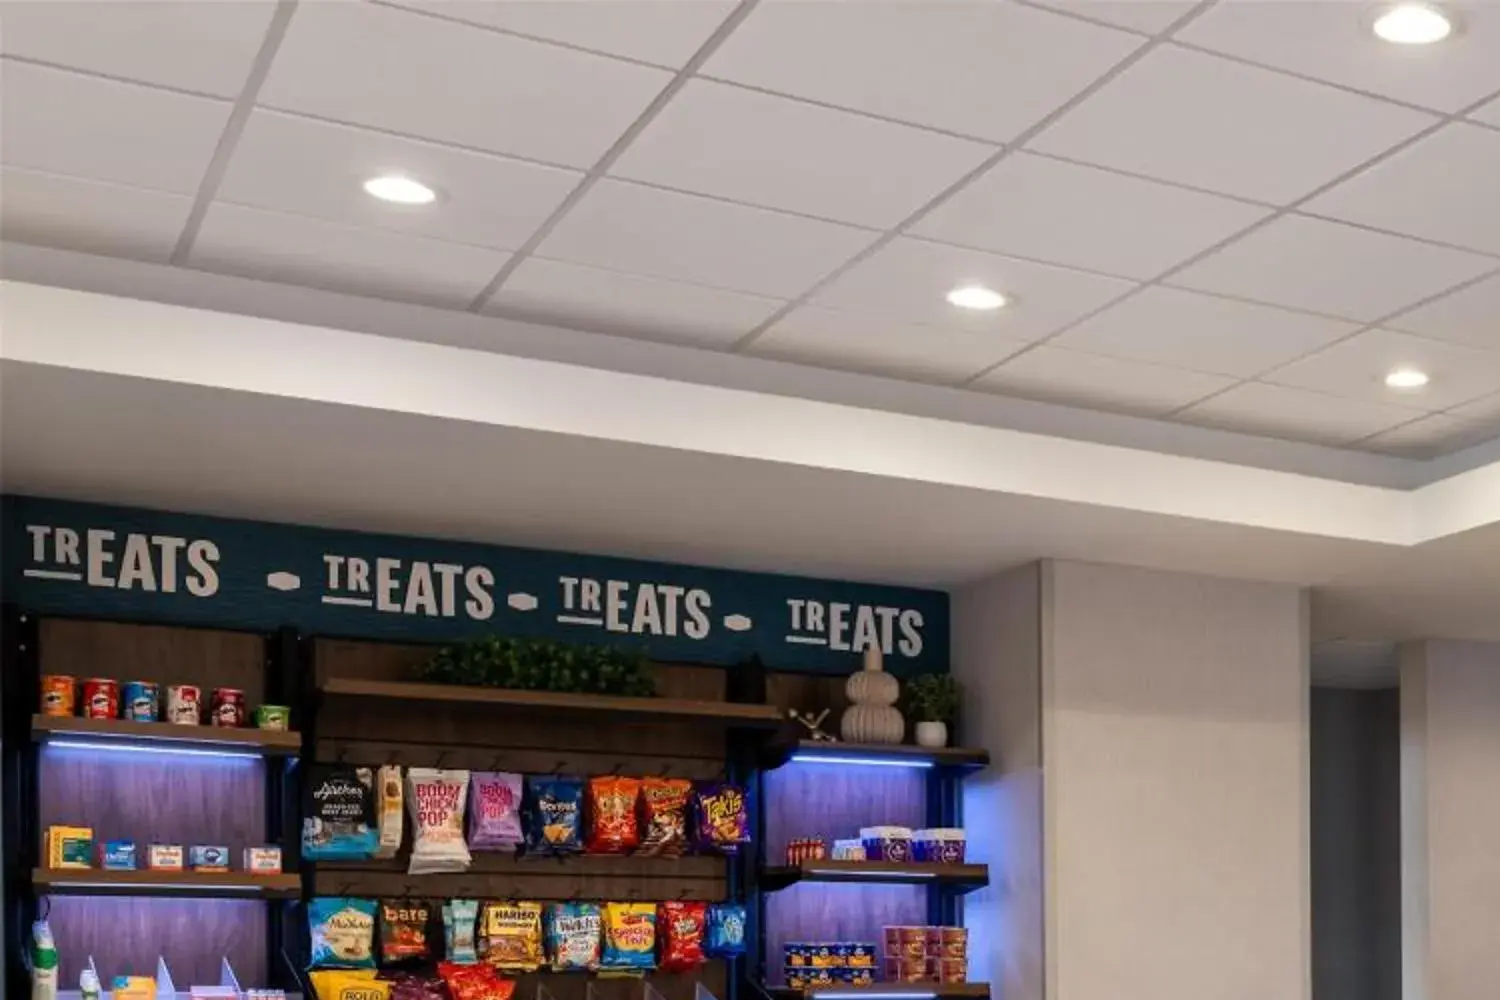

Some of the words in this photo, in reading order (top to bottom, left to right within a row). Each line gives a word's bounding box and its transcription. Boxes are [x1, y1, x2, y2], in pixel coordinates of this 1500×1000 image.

[24, 525, 221, 597] TREATS
[322, 555, 495, 620] TREATS
[557, 576, 712, 640] TREATS
[785, 598, 924, 657] TREATS
[416, 811, 448, 828] POP
[384, 905, 428, 921] bare
